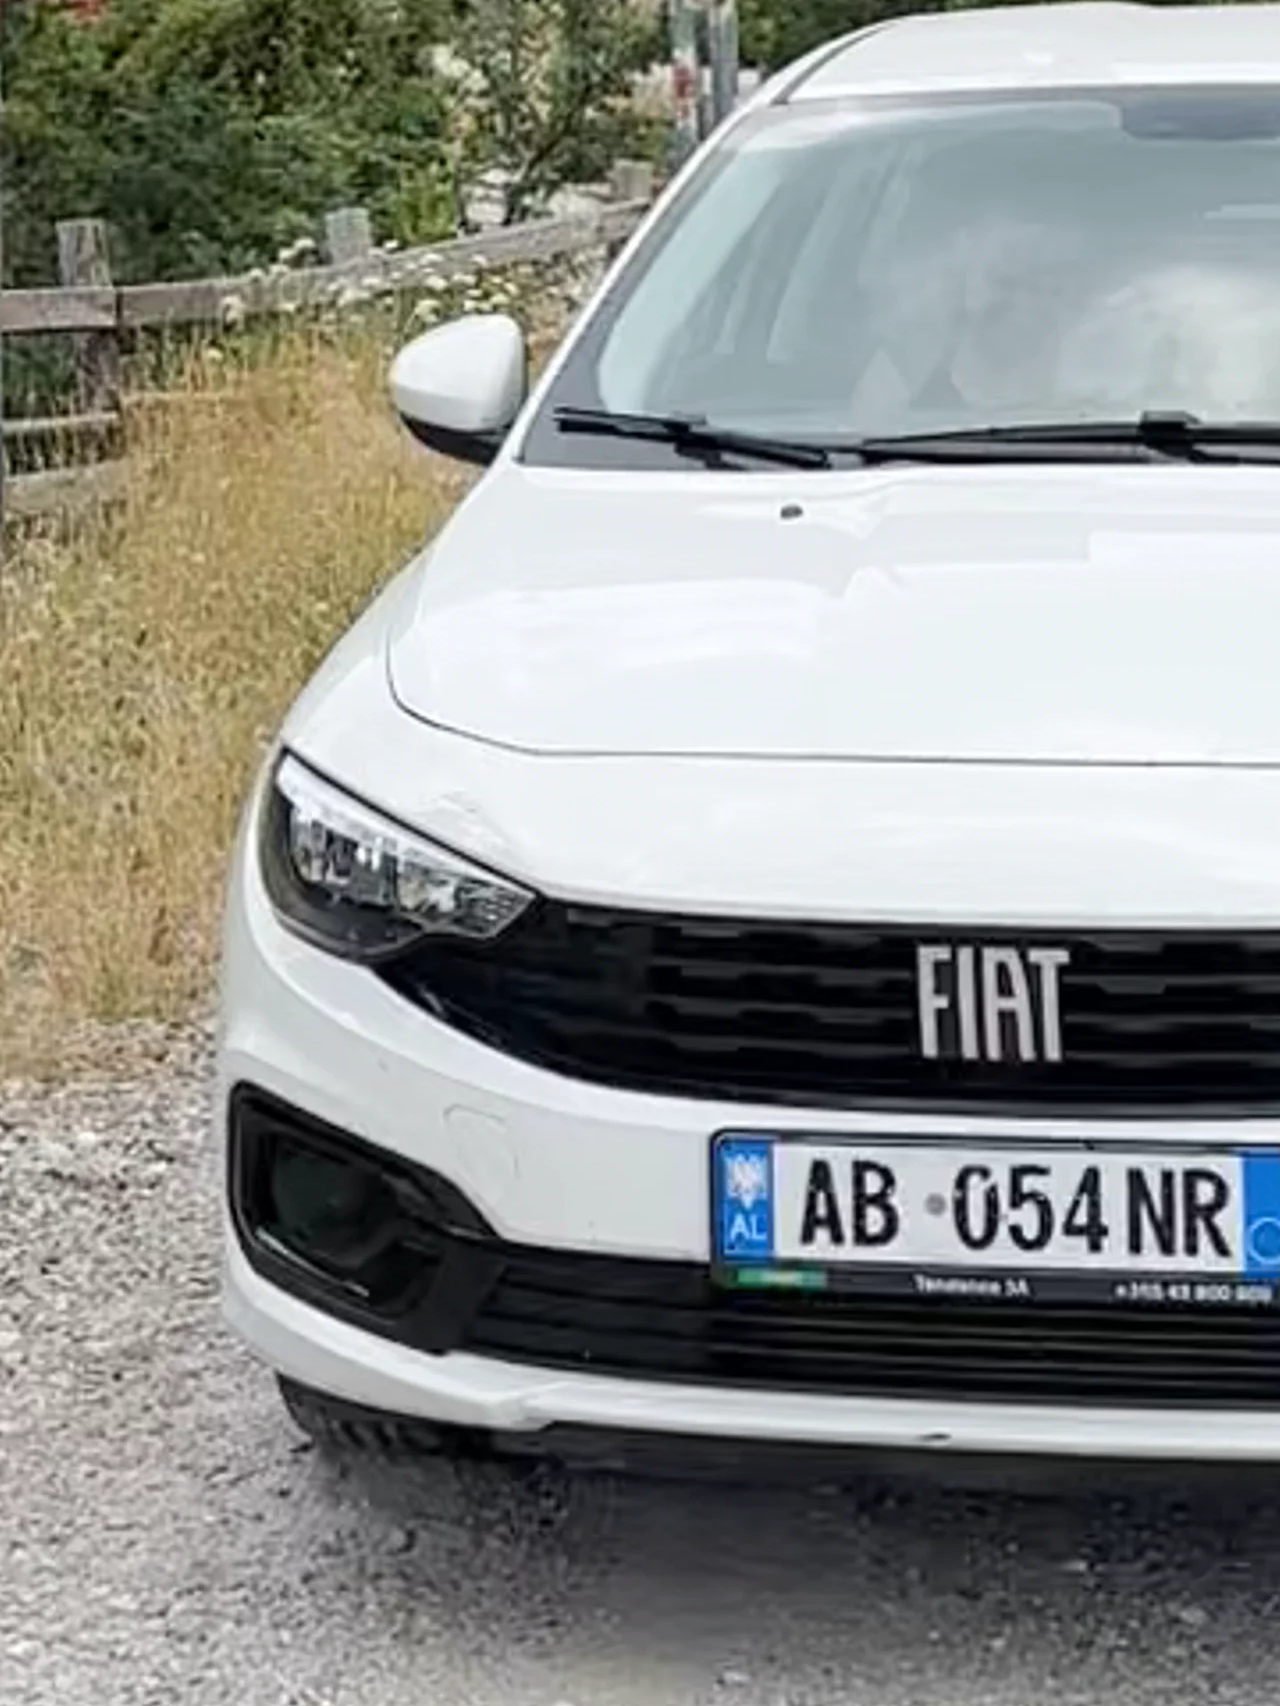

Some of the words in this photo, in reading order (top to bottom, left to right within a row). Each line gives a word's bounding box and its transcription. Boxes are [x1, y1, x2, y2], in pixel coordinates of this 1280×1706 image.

[916, 944, 1072, 1063] FIAT
[729, 1212, 768, 1242] AL
[799, 1159, 901, 1248] AB
[952, 1164, 1111, 1254] 054
[1125, 1166, 1236, 1260] NR
